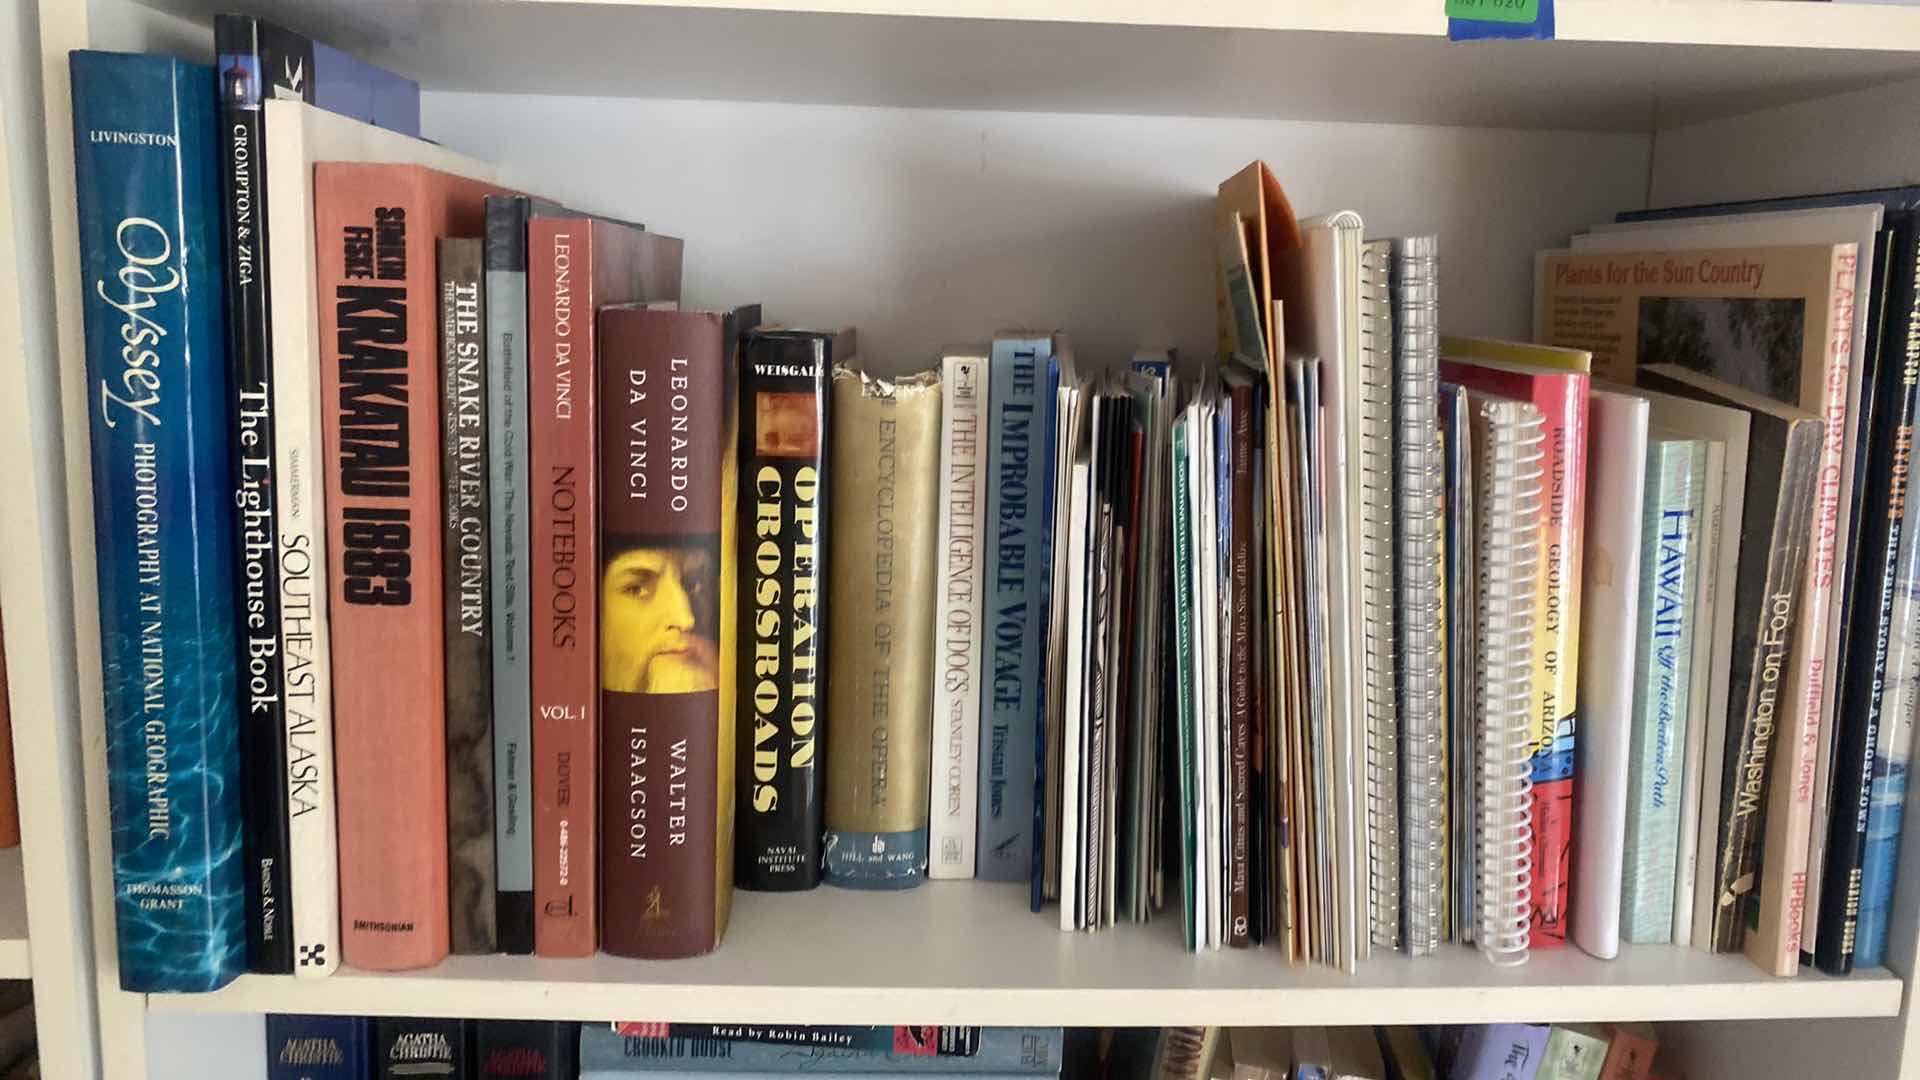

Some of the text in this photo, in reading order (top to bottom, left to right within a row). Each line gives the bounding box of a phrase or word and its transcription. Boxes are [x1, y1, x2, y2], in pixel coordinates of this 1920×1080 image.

[90, 130, 177, 147] LIVINGSTON
[233, 124, 253, 286] CROMPTON & ZIGA
[343, 226, 374, 280] FISKE
[1555, 258, 1766, 289] Plants for the Sun Country
[97, 216, 181, 428] Odyssey
[554, 232, 572, 419] LEONARDO DA VINCI
[502, 333, 514, 391] Battlefield
[1013, 347, 1036, 396] THE
[503, 395, 514, 406] of
[503, 406, 514, 428] the
[1813, 253, 1857, 589] PLANTS for DRY CLIMATES
[336, 285, 412, 607] KRAKATAU 1883
[455, 282, 483, 637] THE SNAKE RIVER COUNTRY
[503, 431, 515, 457] Cold
[629, 369, 647, 500] DA VINCI
[670, 358, 688, 512] LEONARDO
[952, 415, 977, 456] THE
[504, 490, 516, 511] The
[875, 419, 897, 612] ENCYCLOPEDIA
[997, 403, 1034, 594] IMPROBABLE
[236, 382, 278, 714] The Lighthouse Book
[505, 514, 516, 555] Nevada
[552, 466, 577, 649] NOTEBOOKS
[947, 464, 976, 603] INTELLIGENCE
[1178, 461, 1189, 657] SOUTHWESTERN DESERT PLANTS
[505, 558, 516, 581] Test
[1654, 509, 1695, 638] HAWAII
[790, 465, 819, 771] OPERATION
[947, 609, 972, 637] OF
[1540, 427, 1566, 774] ROADSIDE GEOLOGY OF ARIZONA
[134, 443, 170, 841] PHOTOGRAPHY AT NATIONAL GEOGRAPHIC
[752, 465, 783, 814] CROSSROADS
[874, 622, 892, 658] OF
[1856, 425, 1913, 832] RHYOLITE THE TRUE STORY OF A GHOST TOWN
[281, 533, 319, 818] SOUTHEAST ALASKA
[945, 639, 971, 693] DOGS
[993, 601, 1028, 712] VOYAGE
[540, 705, 586, 720] VOL. I
[872, 667, 891, 720] THE
[1660, 674, 1674, 700] the
[1737, 591, 1792, 817] Washington on Foot
[949, 699, 963, 760] STANLEY
[990, 724, 1009, 777] Tristan
[1656, 701, 1673, 764] Beaten
[1798, 658, 1824, 803] Duffield & Jones
[557, 752, 571, 807] DOVER
[630, 727, 648, 859] ISAACSON
[669, 738, 688, 847] WALTER
[871, 726, 889, 809] OPERA
[948, 767, 961, 817] COREN
[1653, 765, 1669, 809] Path
[1235, 802, 1246, 824] and
[758, 854, 806, 864] INSTITUTE
[767, 845, 797, 855] NAVAL
[769, 864, 796, 873] PRESS
[868, 854, 883, 863] and
[887, 851, 915, 863] WANG
[1234, 827, 1246, 860] Cities
[139, 898, 185, 911] GRANT
[262, 896, 275, 907] &
[1235, 862, 1247, 894] Maya
[1846, 868, 1862, 916] CLARION
[353, 919, 415, 933] SMITHSONIAN
[1786, 872, 1807, 953] HPBooks
[396, 1033, 447, 1046] AGATHA
[712, 1025, 853, 1045] Read by Robin Bailey
